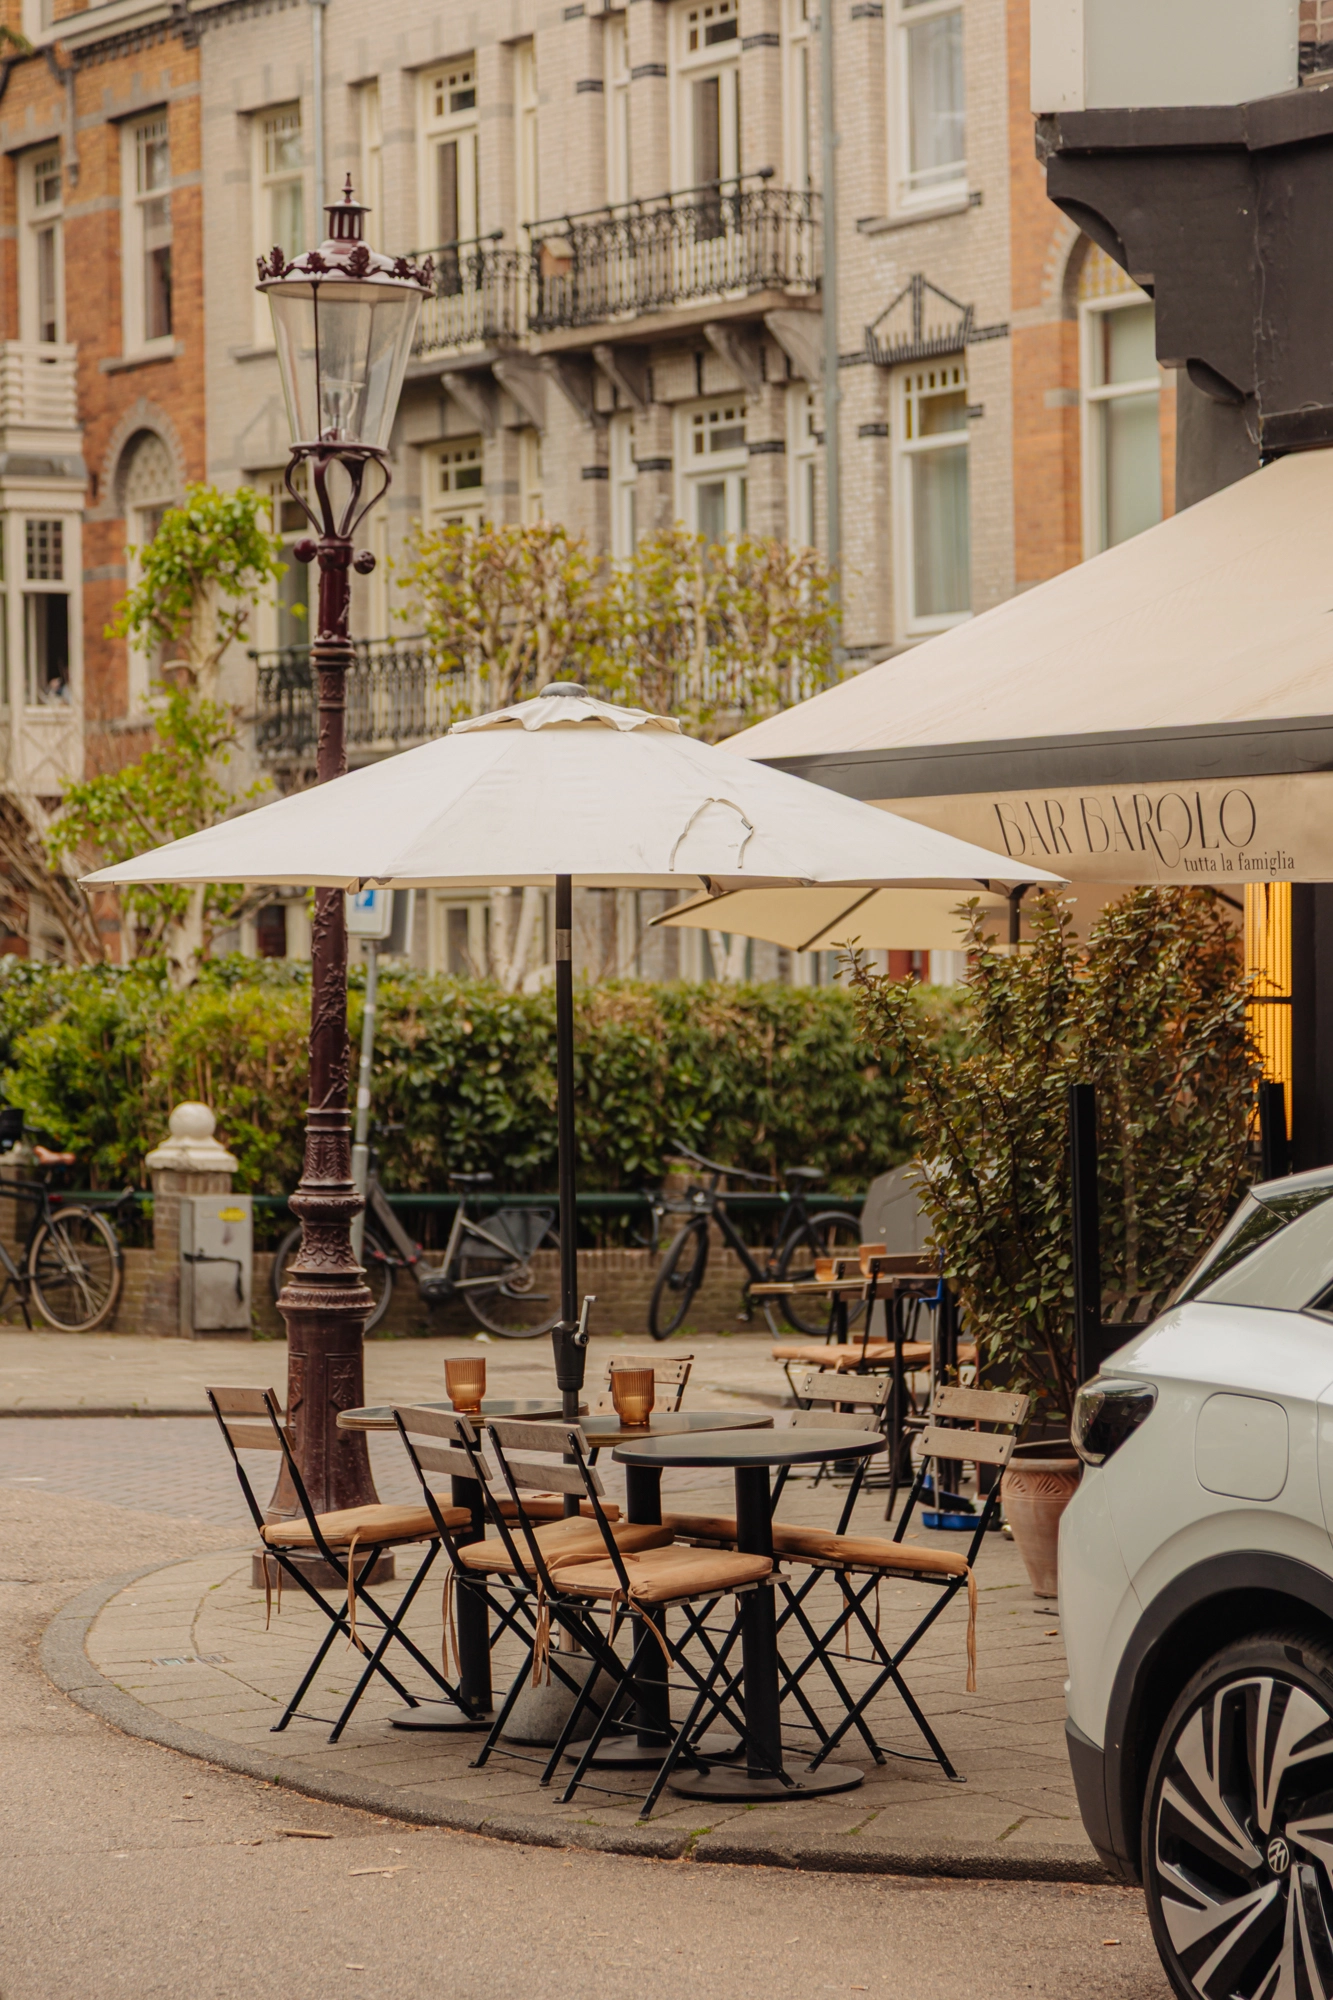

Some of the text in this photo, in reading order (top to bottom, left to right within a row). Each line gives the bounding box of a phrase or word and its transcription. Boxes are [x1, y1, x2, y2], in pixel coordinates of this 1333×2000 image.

[992, 788, 1257, 869] BAR BAROLO
[1184, 851, 1295, 877] tutta la famiglia
